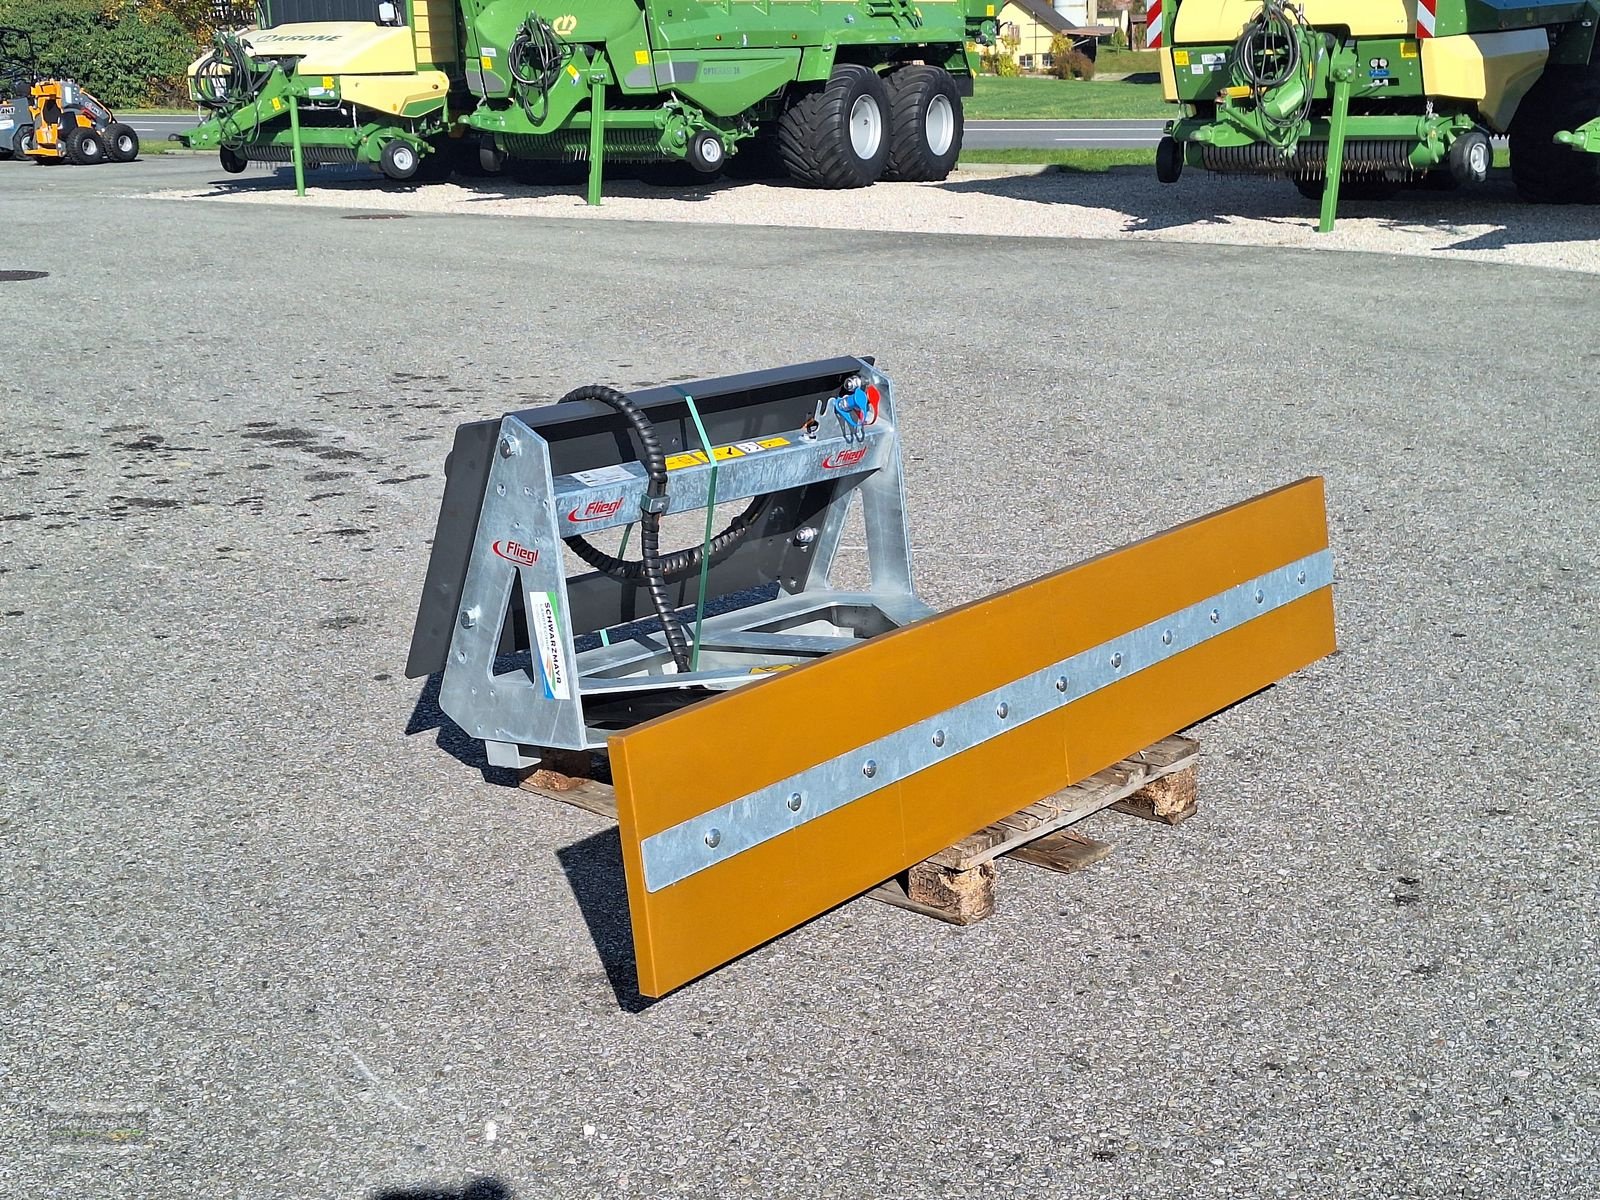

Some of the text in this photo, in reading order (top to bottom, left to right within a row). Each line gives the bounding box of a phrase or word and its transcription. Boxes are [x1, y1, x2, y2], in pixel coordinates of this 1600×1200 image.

[272, 34, 342, 42] KRONE
[835, 446, 867, 463] Fliegl
[584, 497, 623, 515] Fliegl
[506, 541, 539, 564] Fliegl
[544, 602, 562, 684] SCHWARZMAYR
